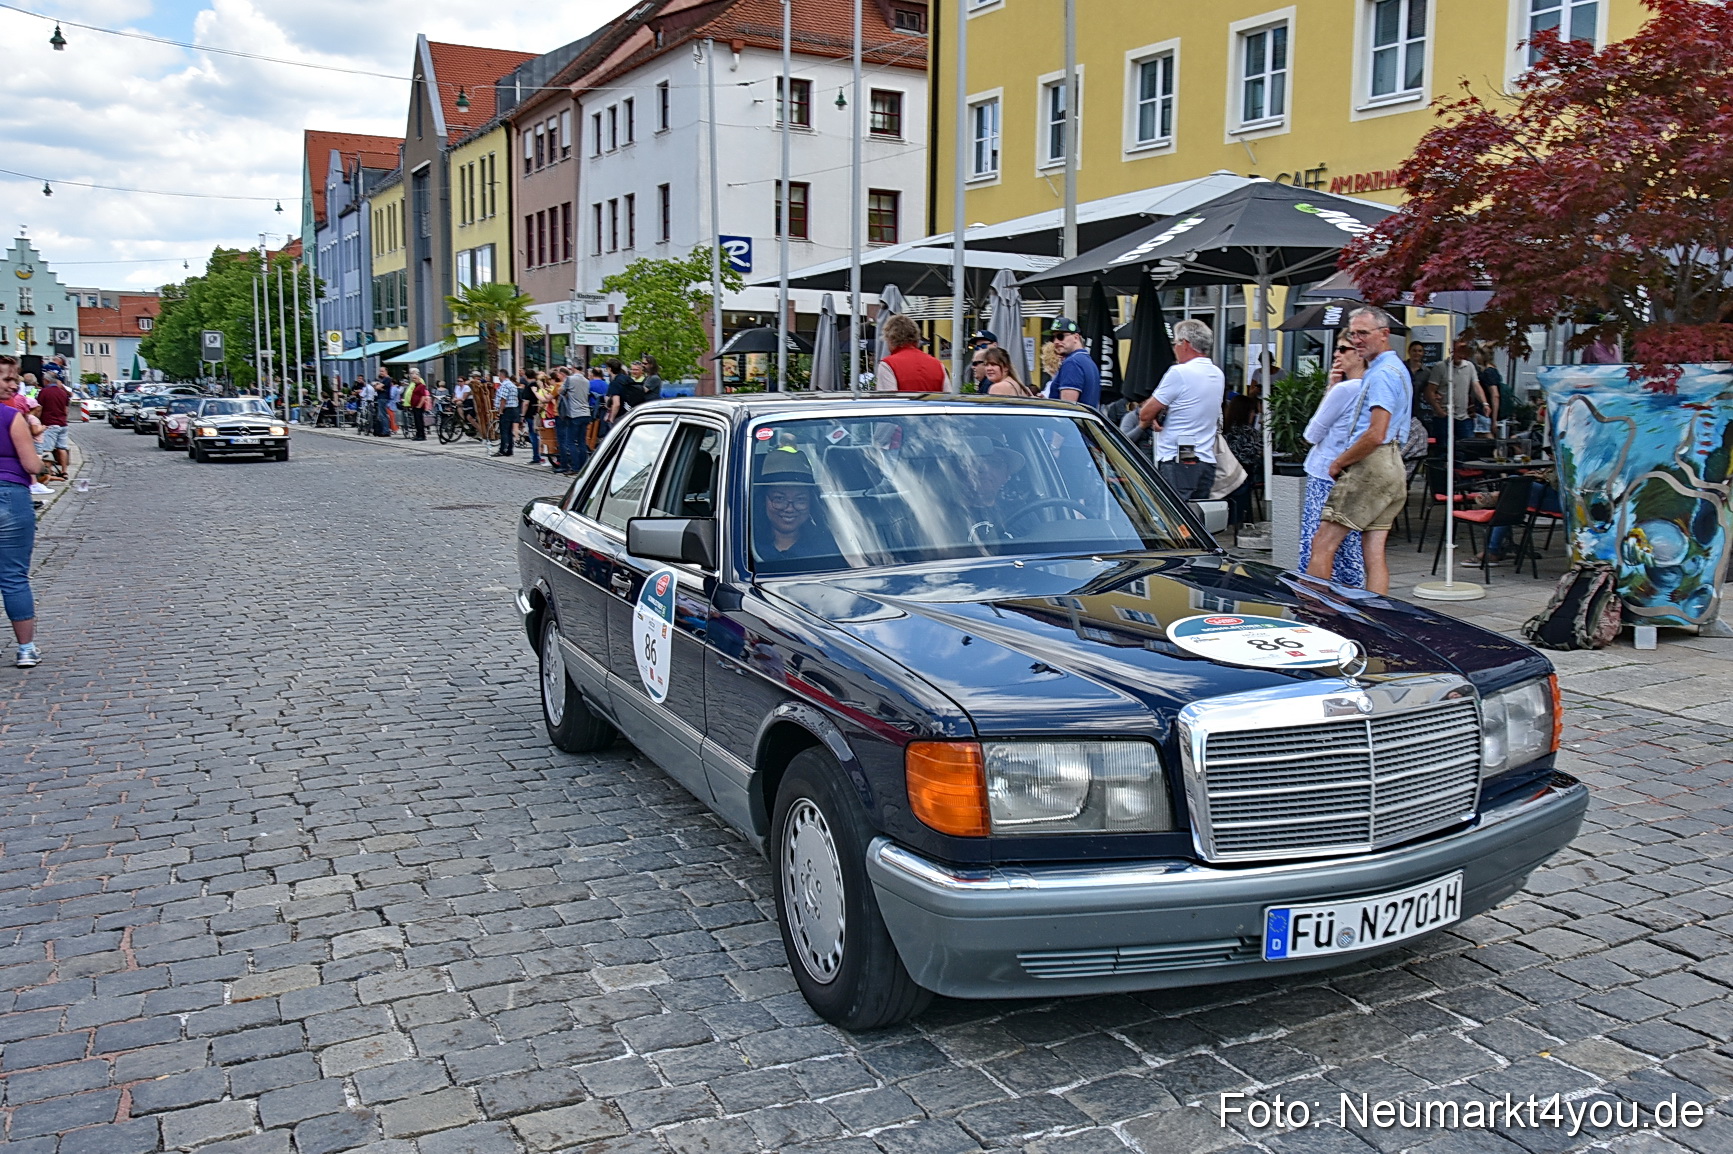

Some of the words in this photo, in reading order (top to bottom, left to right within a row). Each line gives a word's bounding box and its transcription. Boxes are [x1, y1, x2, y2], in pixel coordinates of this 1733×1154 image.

[1329, 174, 1353, 195] AM
[1354, 169, 1401, 192] RATHA
[1321, 306, 1344, 326] now
[645, 633, 657, 666] 86
[1247, 637, 1304, 651] 86
[1291, 911, 1335, 951] FÜ
[1271, 938, 1282, 951] D
